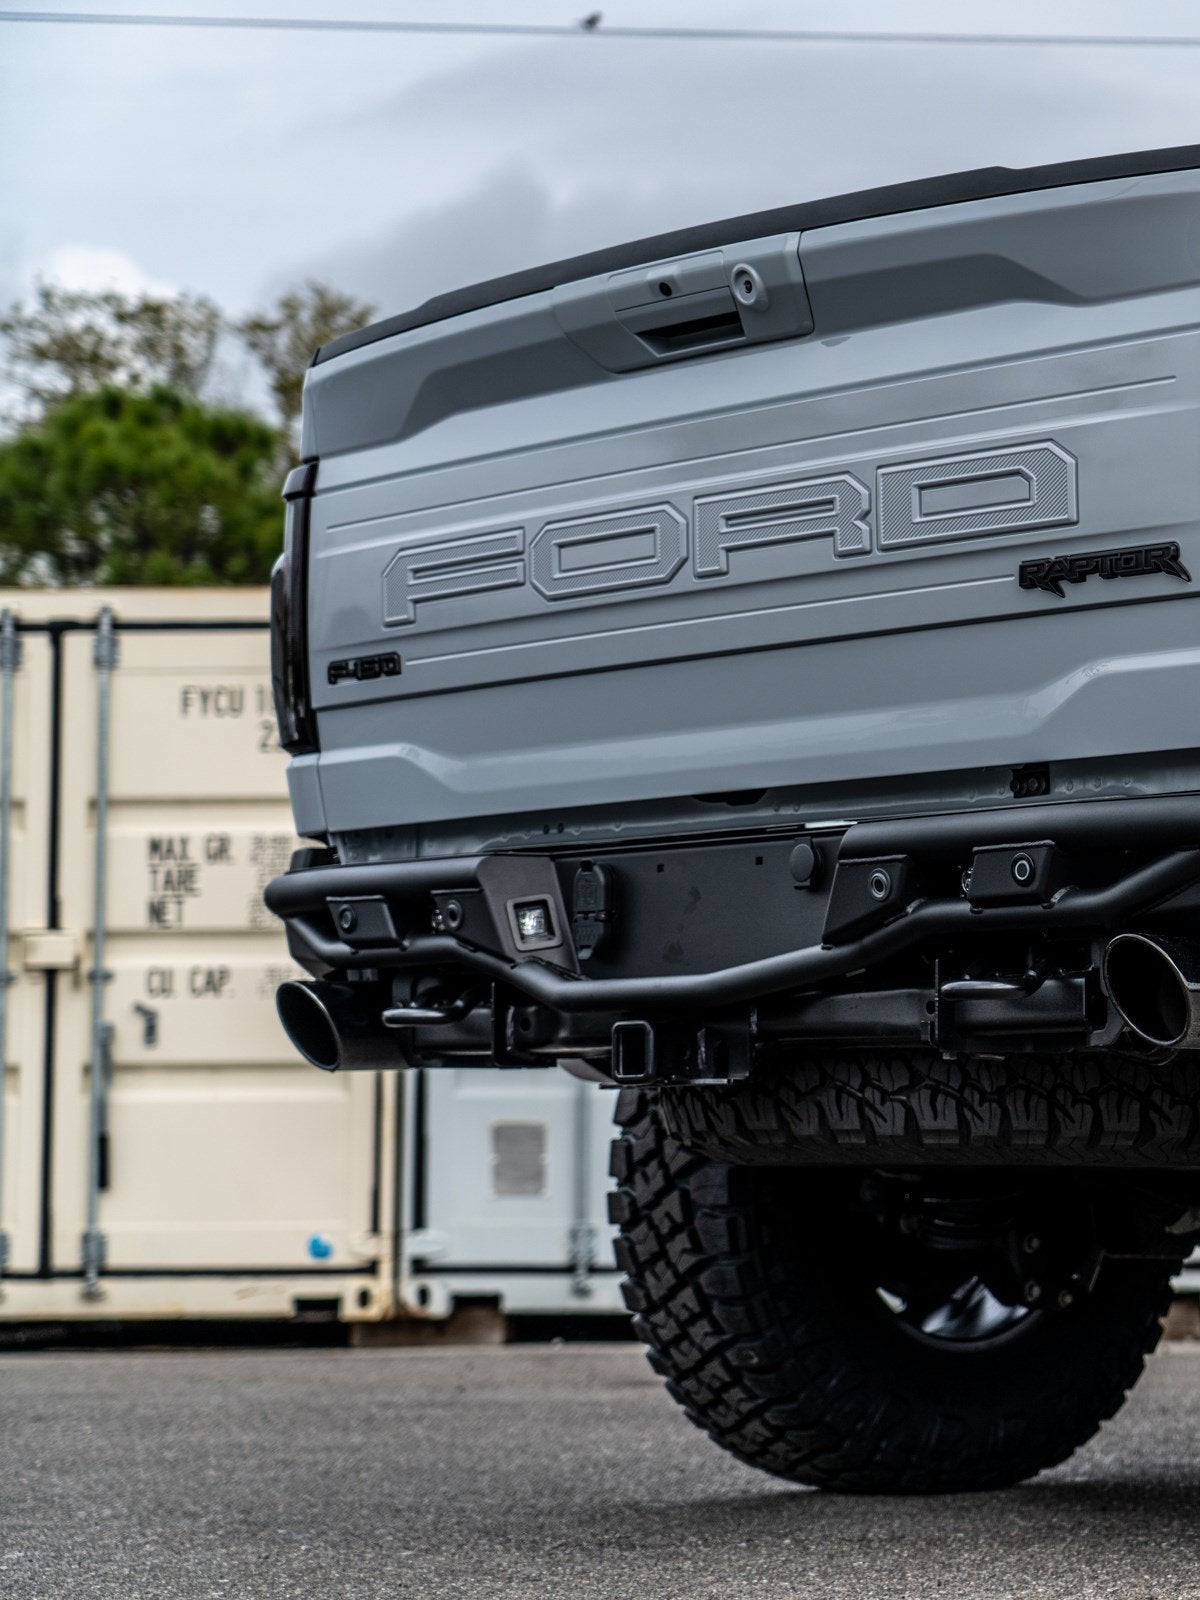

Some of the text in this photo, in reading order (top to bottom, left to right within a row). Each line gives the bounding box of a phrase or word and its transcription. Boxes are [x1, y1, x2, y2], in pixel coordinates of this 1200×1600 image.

[383, 438, 1079, 628] FORD
[1018, 541, 1193, 599] RAPTOR
[180, 684, 245, 718] FYCU
[148, 864, 199, 896] TARE
[147, 898, 184, 929] NET
